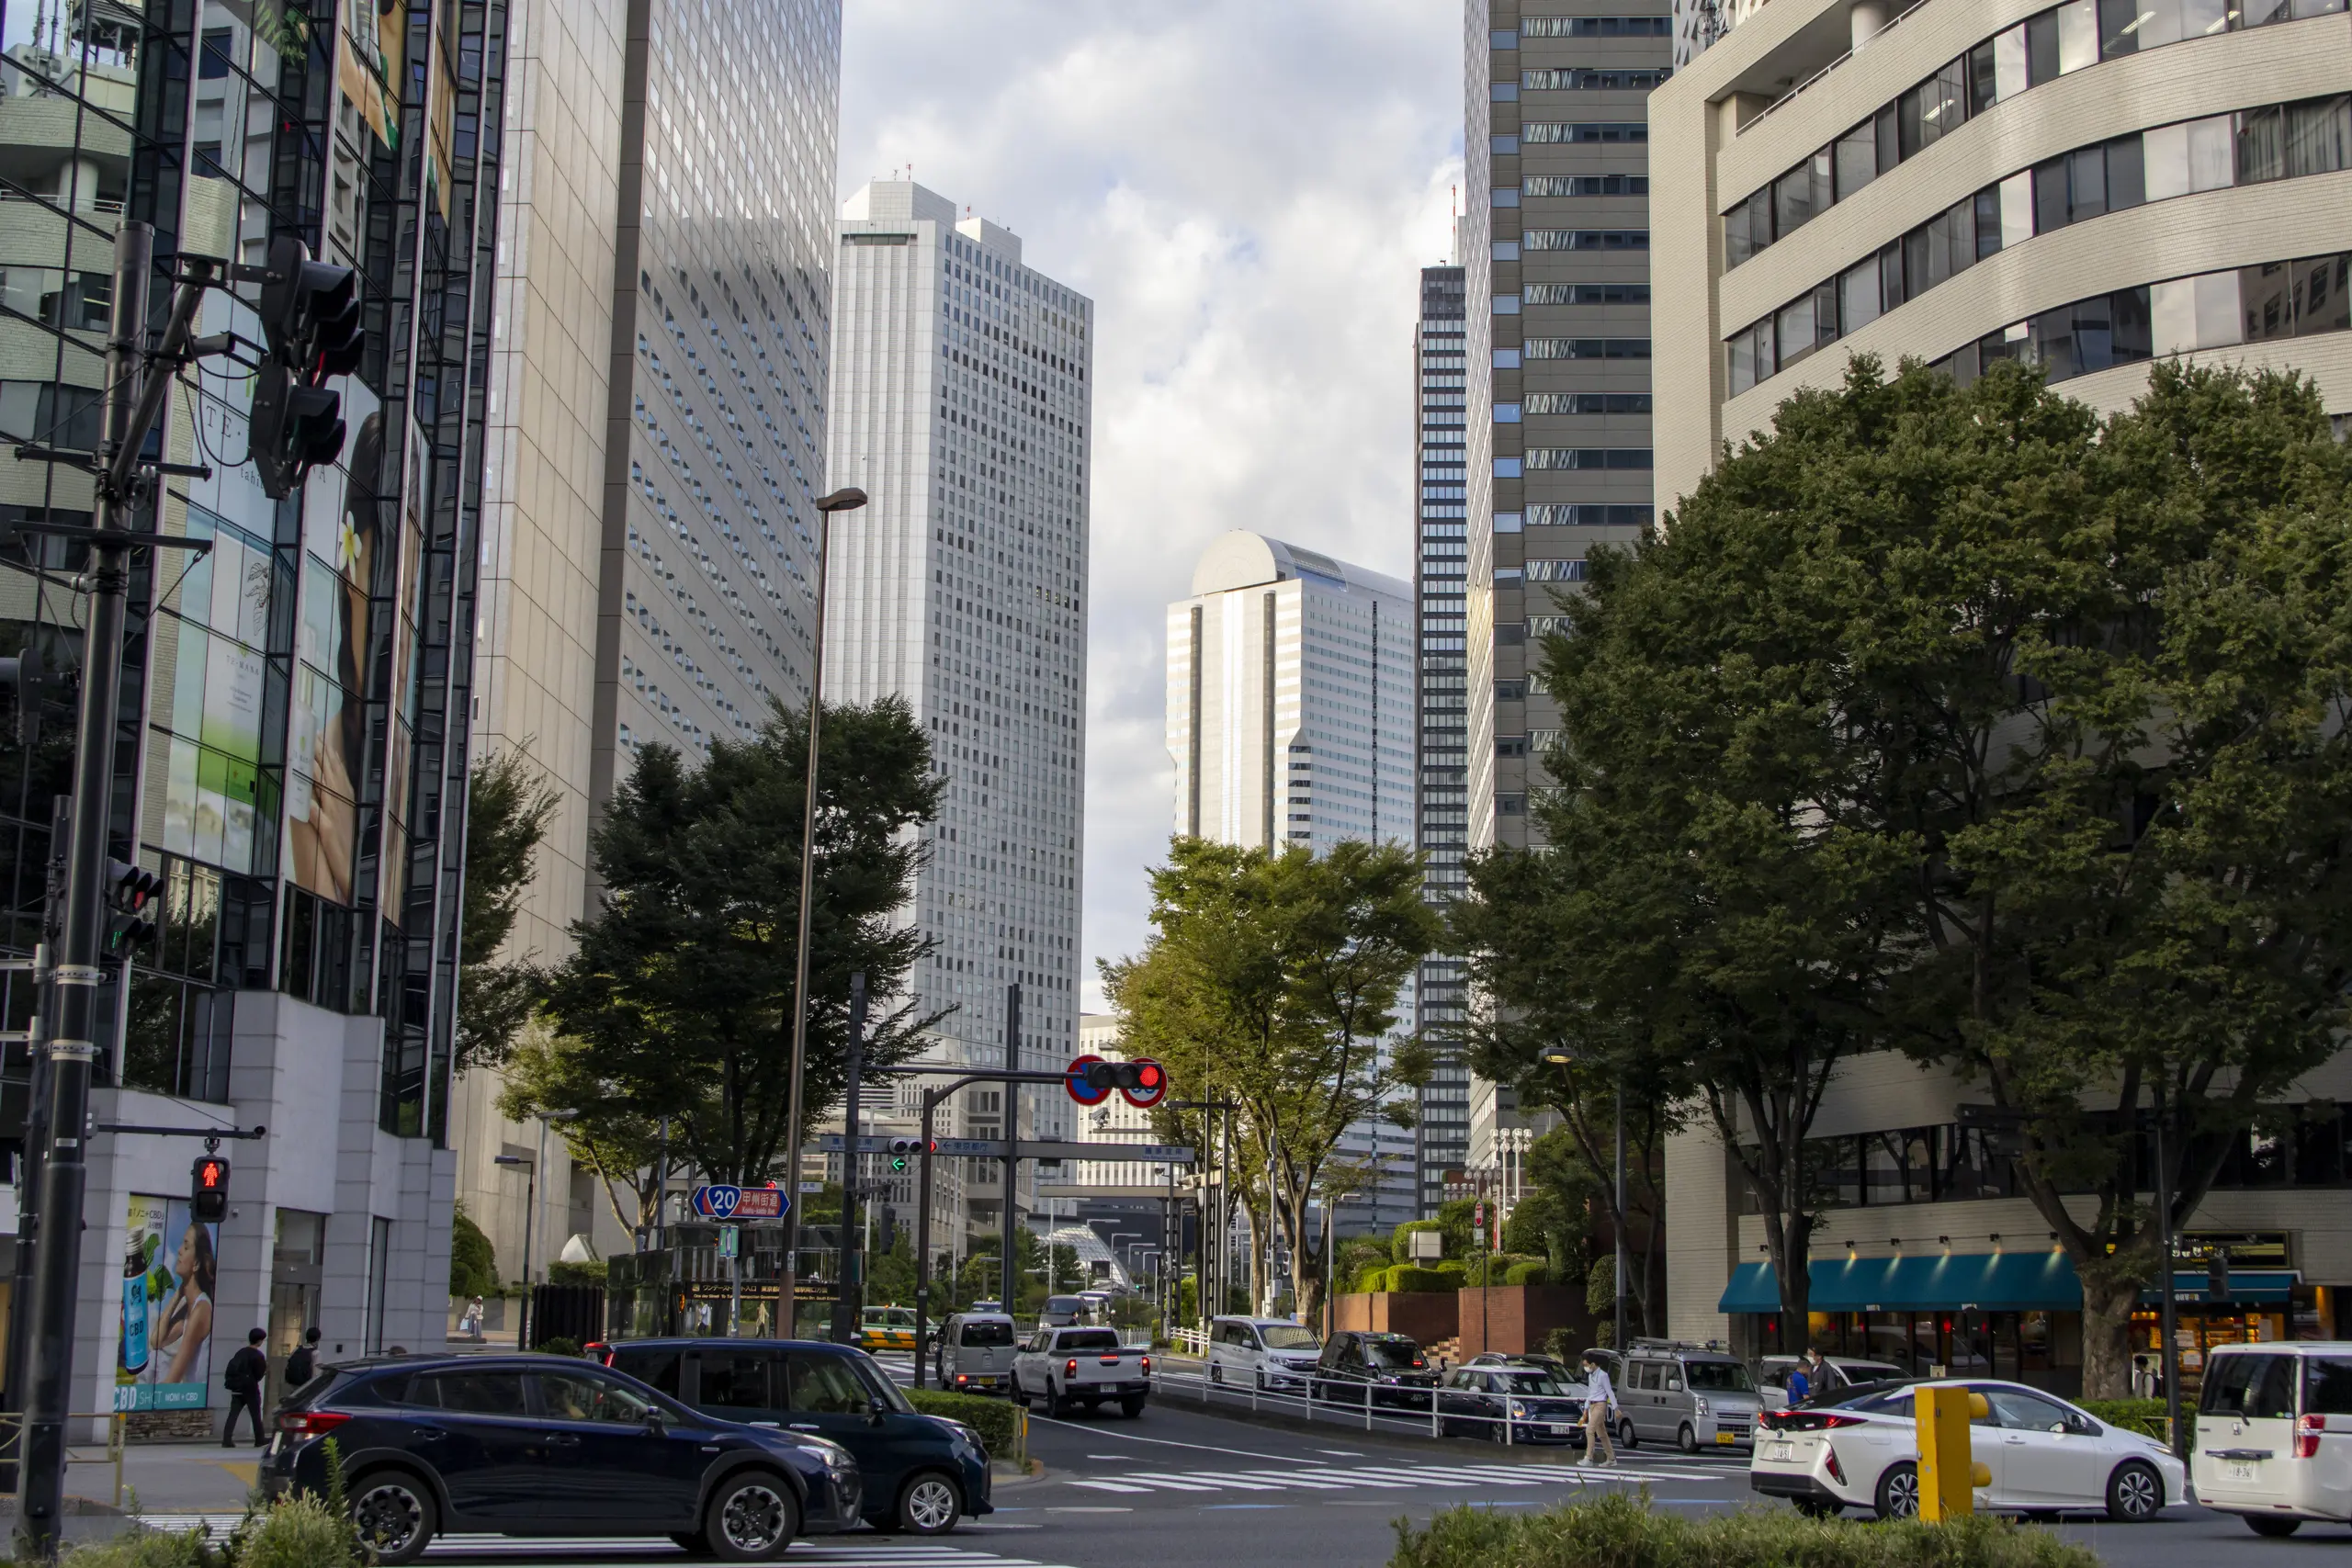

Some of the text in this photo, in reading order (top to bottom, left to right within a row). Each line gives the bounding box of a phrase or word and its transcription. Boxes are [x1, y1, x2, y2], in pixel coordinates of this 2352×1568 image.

[954, 1142, 989, 1151] 東京都庁
[714, 1190, 735, 1210] 20
[742, 1191, 778, 1208] 甲州街道
[130, 1321, 144, 1337] CBD
[114, 1385, 138, 1411] CBD
[186, 1392, 198, 1402] CBD
